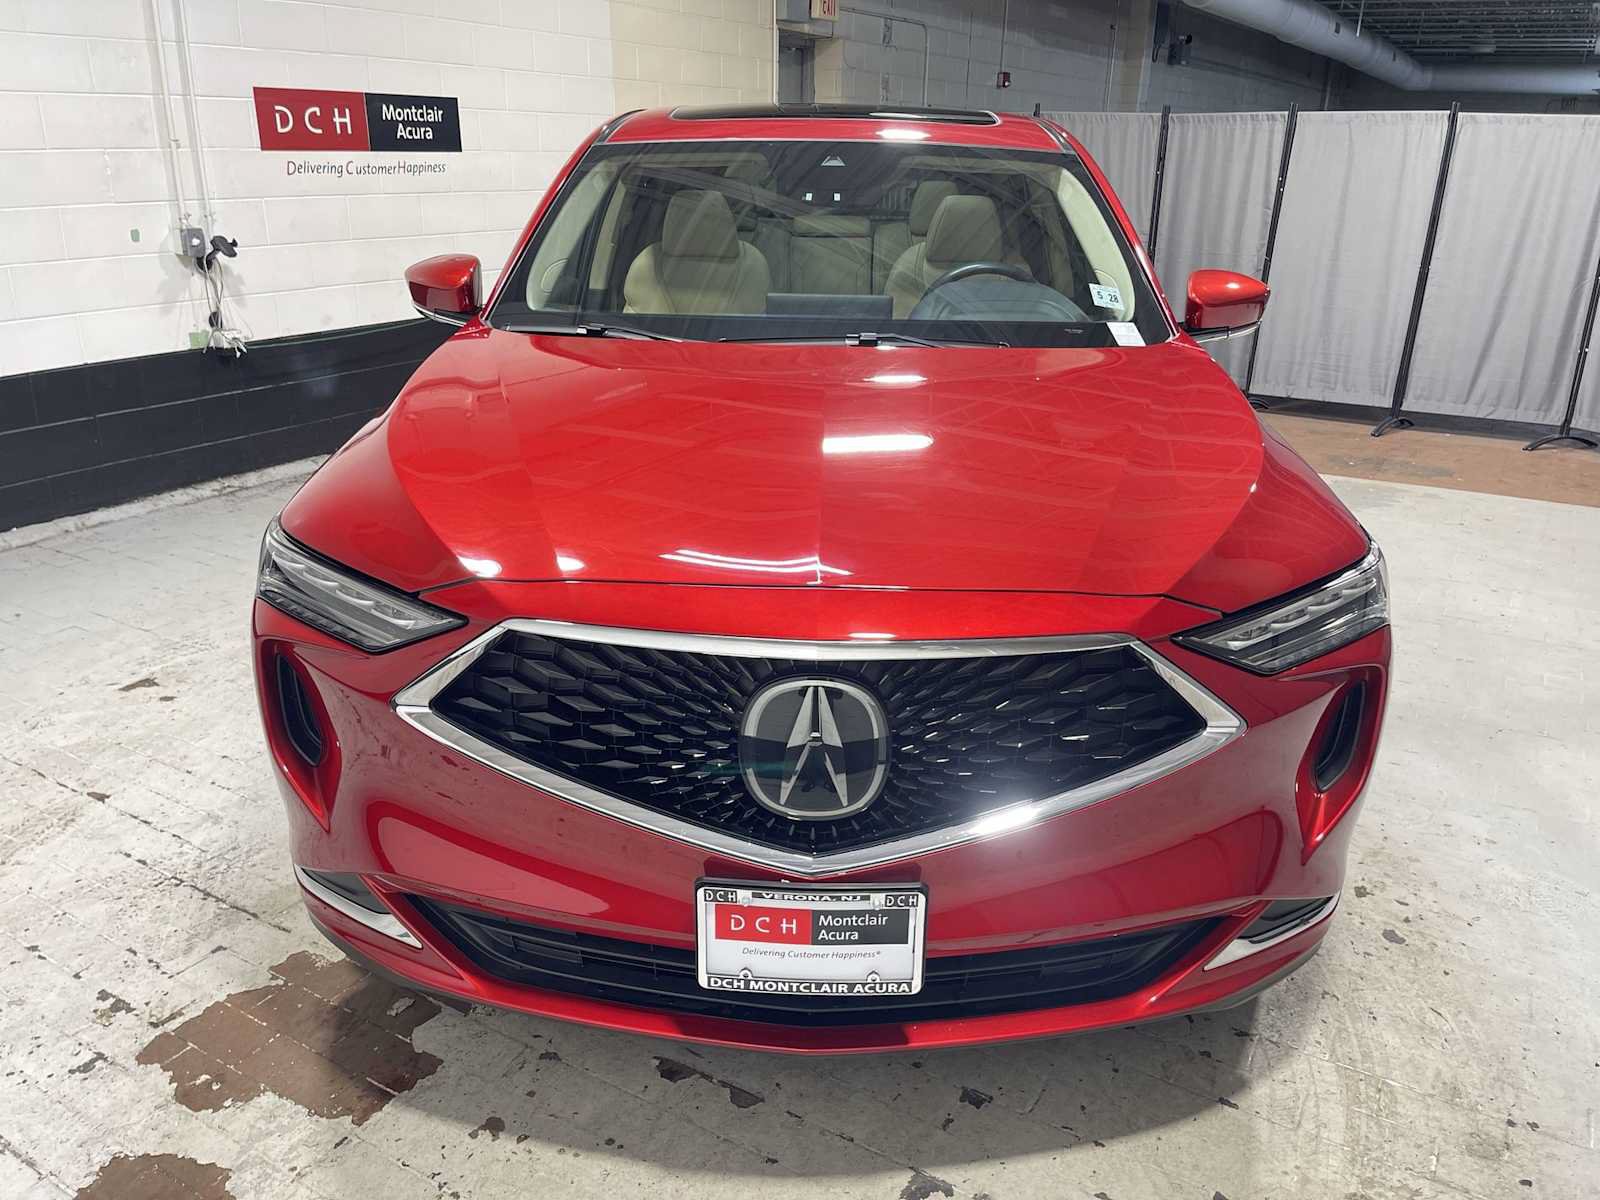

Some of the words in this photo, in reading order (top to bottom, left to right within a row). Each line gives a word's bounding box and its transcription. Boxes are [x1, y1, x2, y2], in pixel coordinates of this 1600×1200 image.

[382, 104, 444, 123] Montclair
[396, 123, 434, 140] Acura
[286, 160, 344, 178] Delivering
[705, 890, 737, 902] DCH
[843, 894, 862, 902] NJ
[886, 896, 917, 906] DCH
[818, 914, 889, 928] Montclair
[817, 929, 859, 941] Acura
[742, 947, 786, 959] Delivering
[787, 950, 830, 959] Customer
[710, 978, 746, 990] DCH
[749, 980, 848, 994] MONTCLAIR
[852, 982, 910, 994] ACURA
